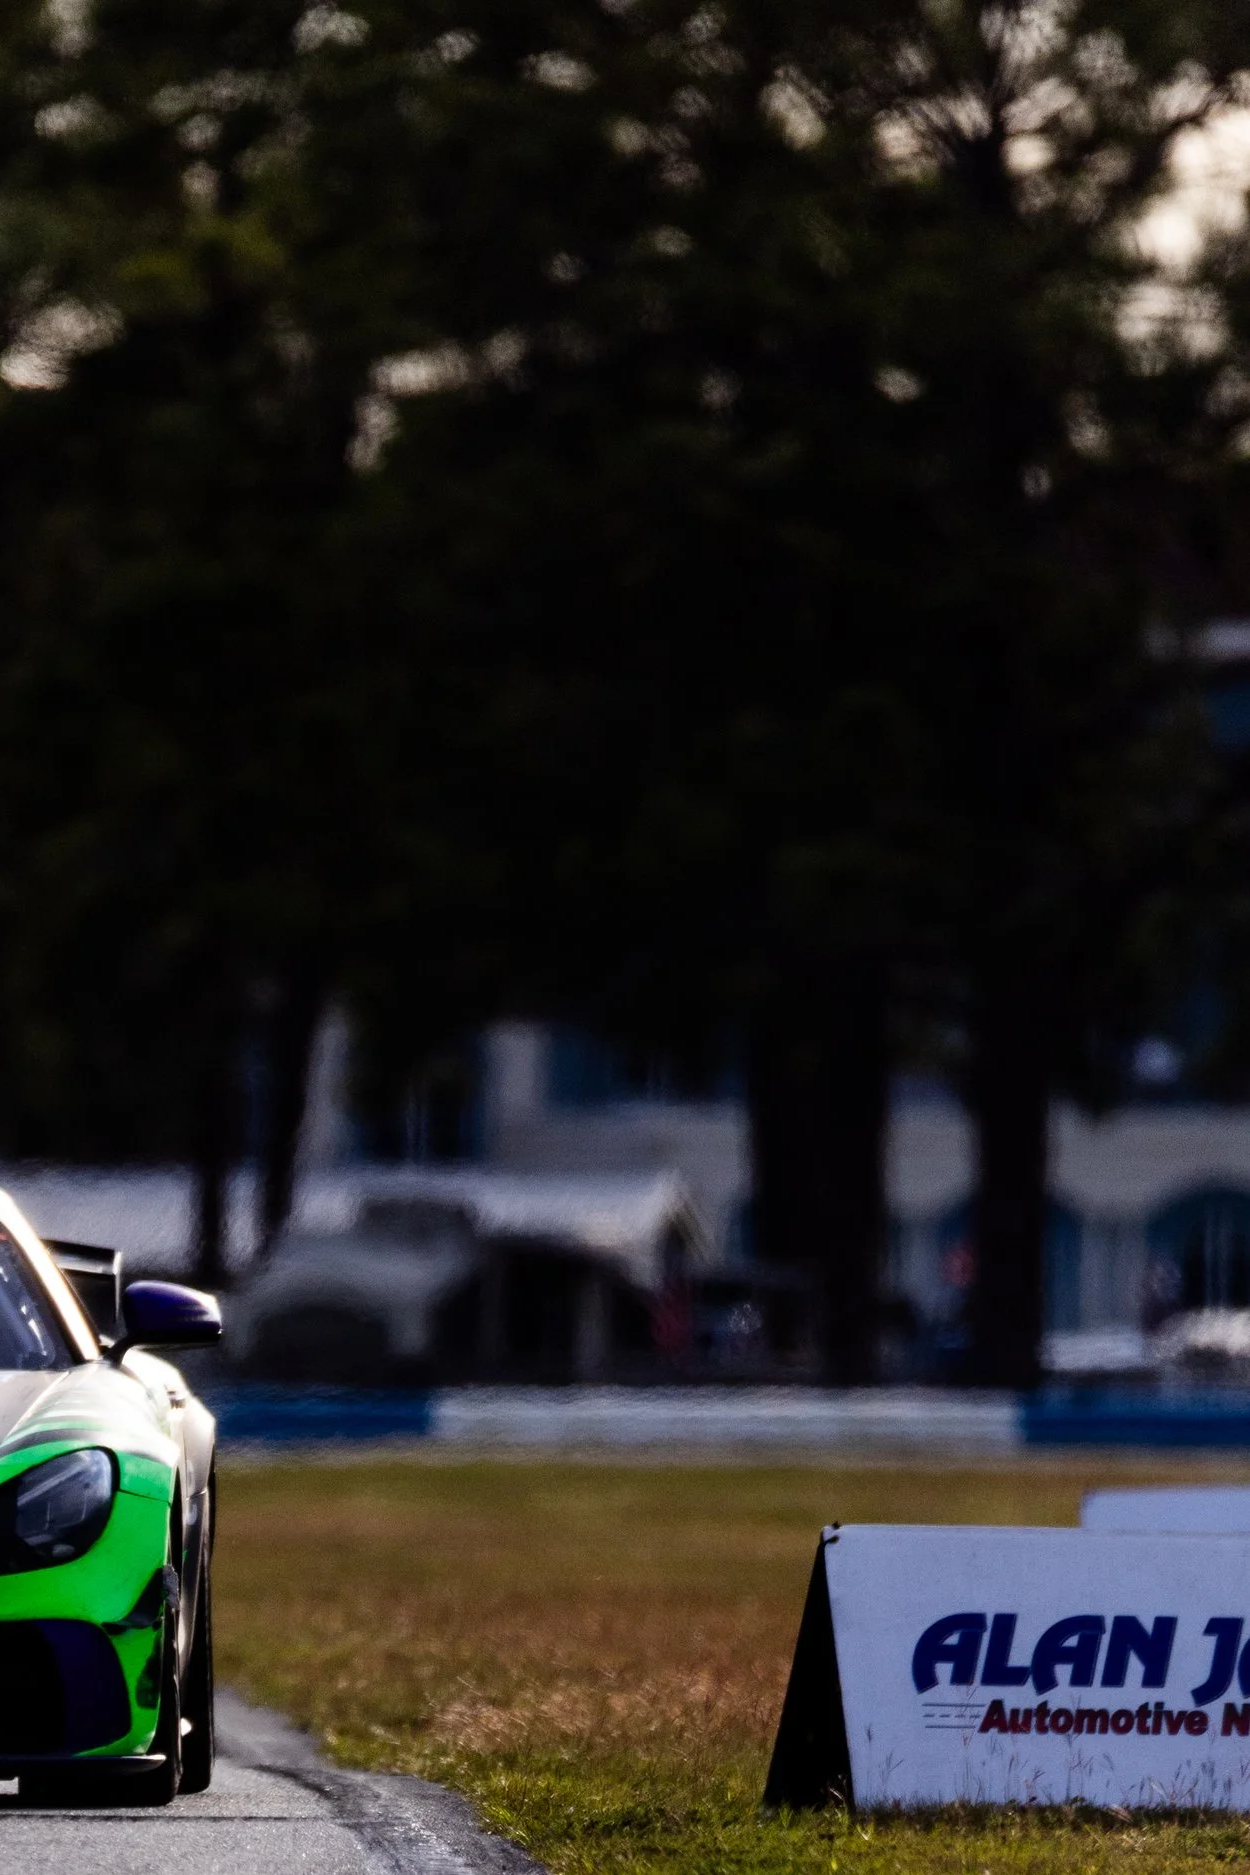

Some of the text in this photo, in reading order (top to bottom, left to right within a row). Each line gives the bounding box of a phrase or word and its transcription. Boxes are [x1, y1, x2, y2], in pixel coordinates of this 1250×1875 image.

[912, 1612, 1250, 1708] ALAN J
[978, 1700, 1209, 1736] Automotive
